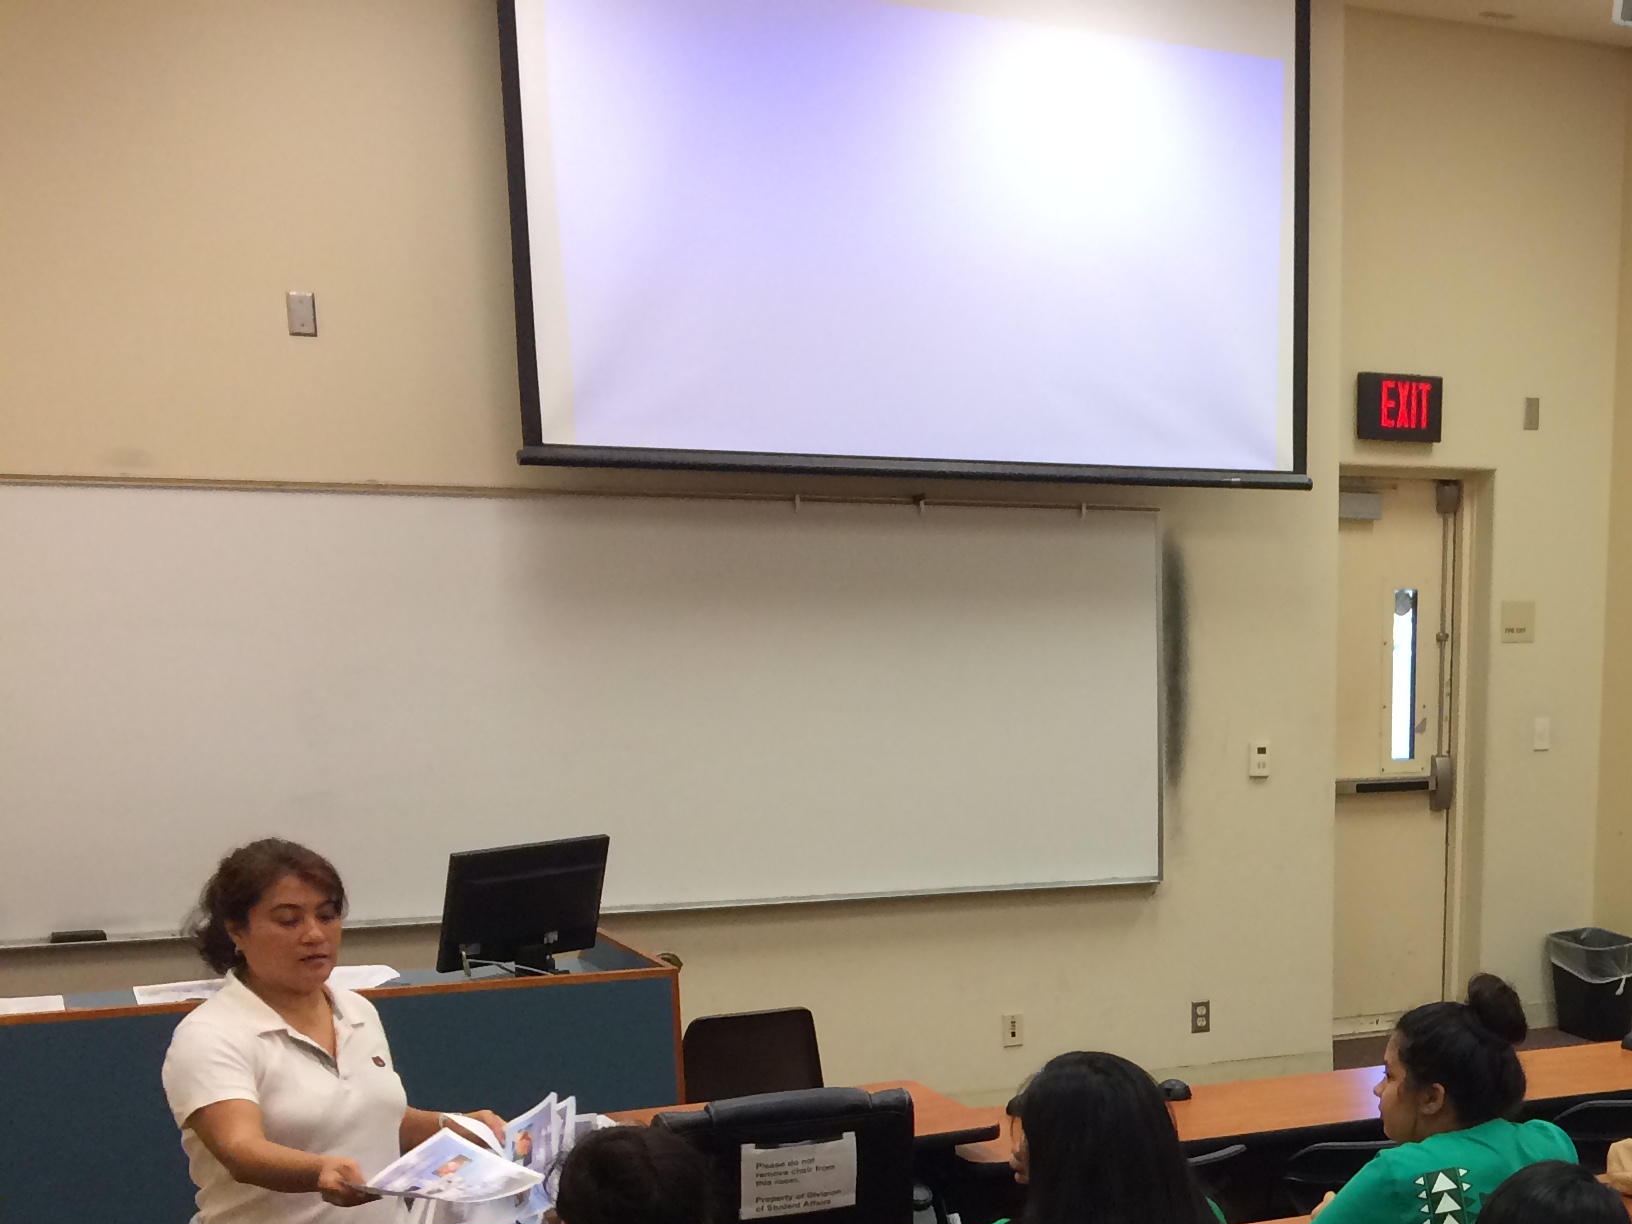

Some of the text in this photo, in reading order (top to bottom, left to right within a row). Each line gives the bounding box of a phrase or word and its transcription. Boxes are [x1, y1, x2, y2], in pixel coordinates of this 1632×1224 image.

[1380, 379, 1432, 430] EXIT
[755, 1161, 785, 1170] Please
[801, 1157, 815, 1165] not
[755, 1164, 836, 1178] remove chair from
[755, 1179, 772, 1187] this
[755, 1194, 793, 1204] Property
[806, 1188, 842, 1199] Division
[755, 1199, 832, 1213] of Student Affairs
